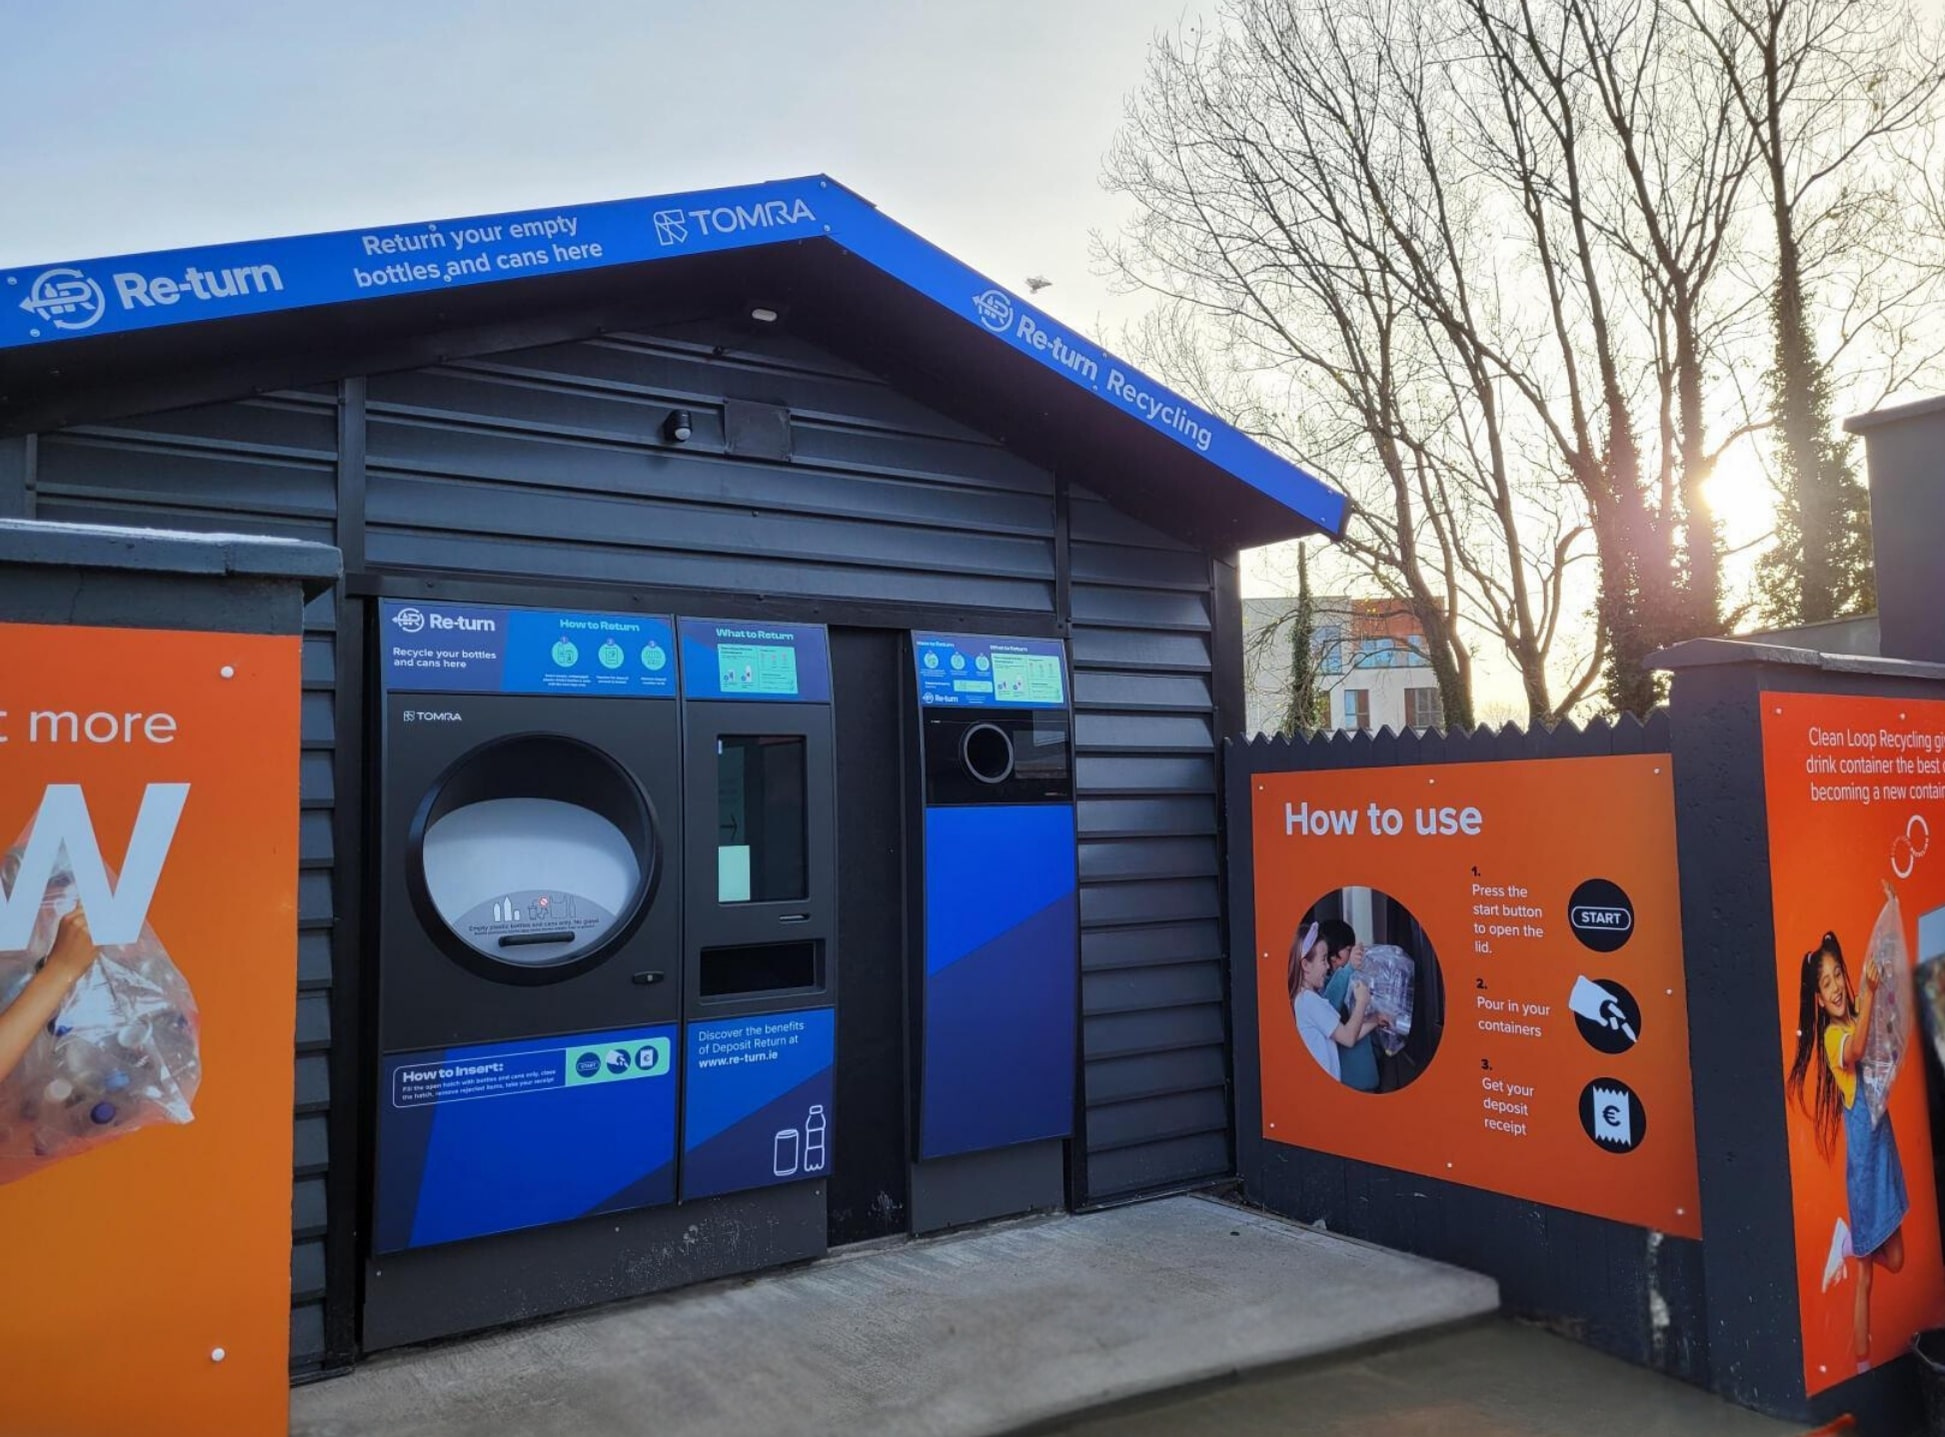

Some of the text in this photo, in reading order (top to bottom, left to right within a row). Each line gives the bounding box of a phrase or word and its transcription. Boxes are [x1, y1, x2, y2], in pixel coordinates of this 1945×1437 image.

[688, 198, 816, 236] TOMRA
[361, 215, 578, 256] Return your empty
[353, 241, 603, 288] bottles and cans here
[112, 263, 285, 311] Re-turn
[1016, 314, 1213, 451] Re-turn Recycling
[429, 613, 496, 632] Re-turn
[560, 619, 640, 632] How to Return
[715, 628, 794, 640] What to Return
[393, 647, 497, 660] Recycle your bottles
[393, 658, 467, 669] and cans here
[416, 712, 462, 721] TOMRA
[29, 710, 178, 744] more
[1808, 726, 1844, 747] Clean
[1847, 728, 1877, 751] Loop
[1879, 729, 1932, 753] Recycling
[1806, 754, 1837, 774] drink
[1839, 756, 1894, 774] container
[1896, 755, 1914, 774] the
[1917, 755, 1941, 774] best
[1810, 781, 1870, 805] becoming
[1873, 785, 1880, 800] a
[1883, 785, 1906, 800] new
[1285, 801, 1483, 836] How to use
[1471, 866, 1481, 877] 1.
[1472, 883, 1528, 898] Press the
[1473, 904, 1543, 918] start button
[1581, 911, 1622, 925] START
[1474, 923, 1543, 938] to open the
[1474, 941, 1492, 954] lid.
[1476, 978, 1488, 989] 2.
[1477, 996, 1551, 1017] Pour in your
[698, 1021, 805, 1042] Discover the benefits
[1478, 1019, 1542, 1038] containers
[698, 1035, 799, 1055] of Deposit Return at
[698, 1050, 778, 1068] www.re-turn.ie
[1481, 1059, 1493, 1071] 3.
[403, 1062, 504, 1083] How to Insert:
[425, 1083, 442, 1091] open
[475, 1076, 497, 1084] bottles
[519, 1080, 534, 1088] your
[1482, 1077, 1534, 1097] Get your
[1483, 1098, 1529, 1117] deposit
[1484, 1117, 1527, 1137] receipt
